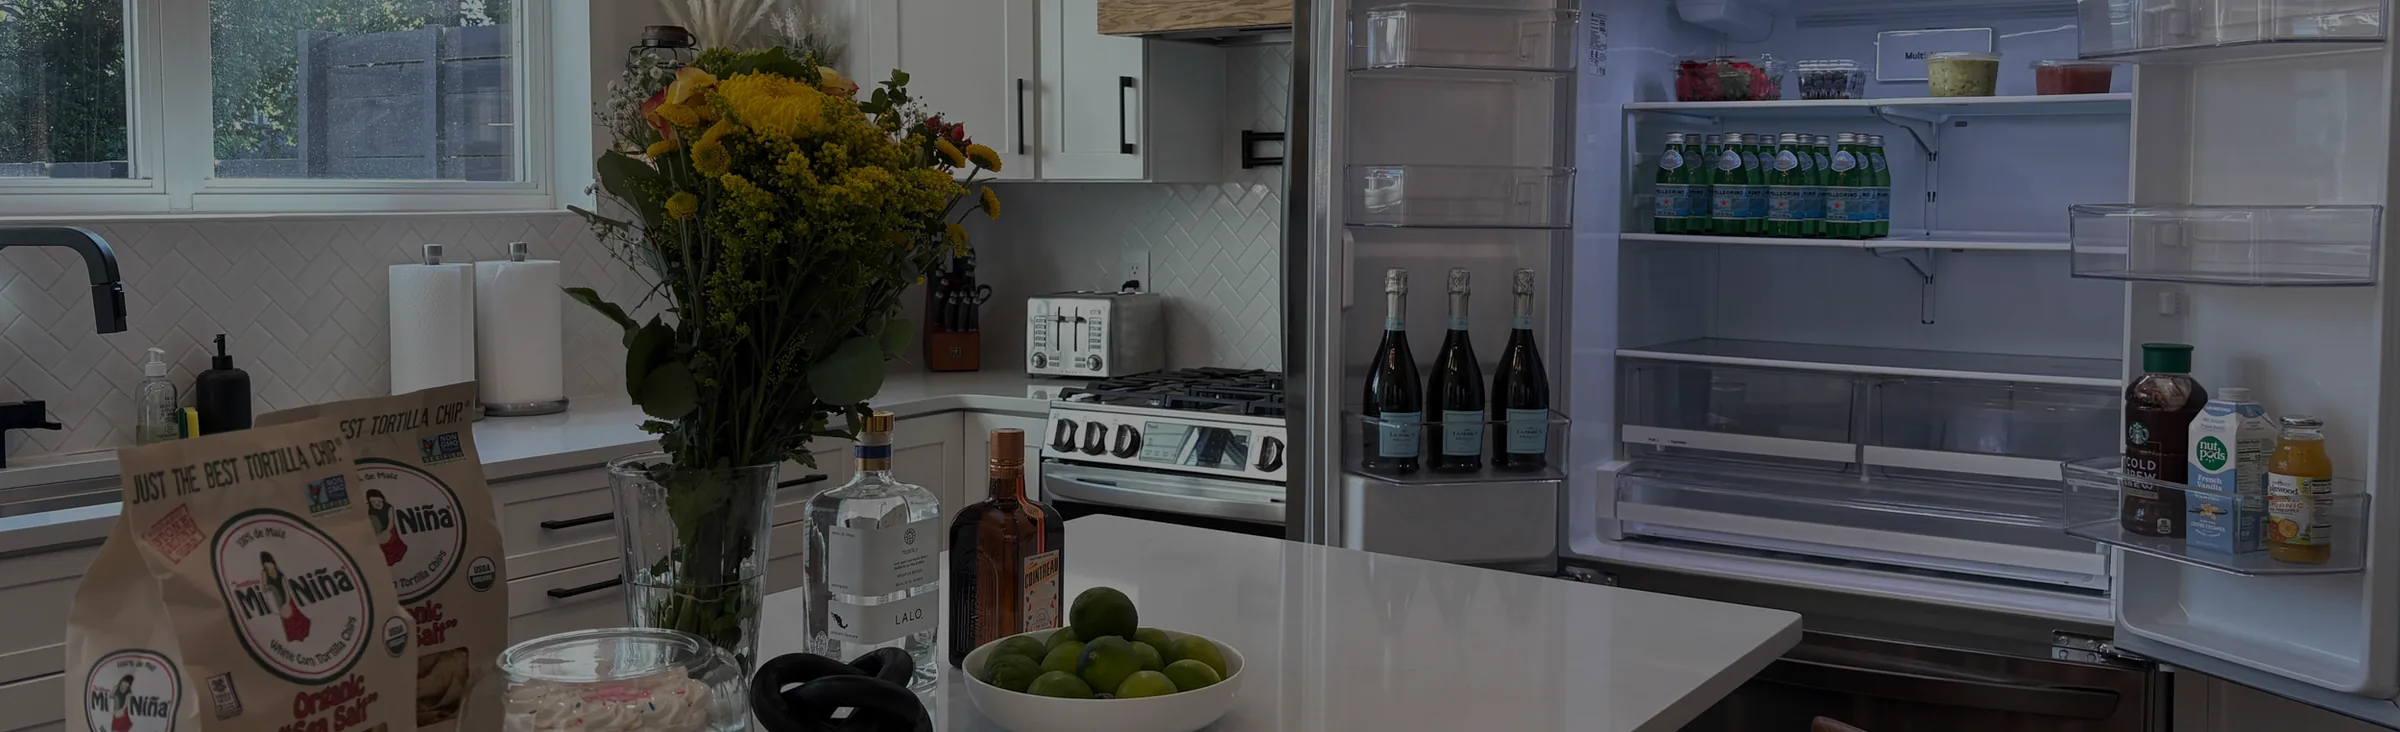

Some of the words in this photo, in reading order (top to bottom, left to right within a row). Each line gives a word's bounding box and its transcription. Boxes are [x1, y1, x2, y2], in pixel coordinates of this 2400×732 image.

[371, 408, 429, 436] TORTILLA
[440, 433, 458, 442] NON
[440, 438, 460, 448] GMO
[2200, 441, 2218, 450] nut
[2126, 457, 2156, 470] COLD
[2200, 448, 2226, 460] pods
[133, 470, 167, 504] JUST
[172, 465, 200, 496] THE
[204, 458, 240, 488] BEST
[244, 445, 310, 481] TORTILLA
[2197, 474, 2222, 485] French
[2197, 481, 2223, 491] Vanilla
[396, 504, 454, 534] Niña
[400, 571, 430, 588] Tortilla
[428, 550, 447, 572] Chips
[1024, 557, 1058, 588] COINTREAU
[235, 584, 272, 620] Mi
[288, 568, 355, 607] Niña
[316, 640, 346, 666] Tortilla
[91, 690, 109, 712] Mi
[130, 696, 168, 718] Niña
[293, 674, 365, 719] Organic
